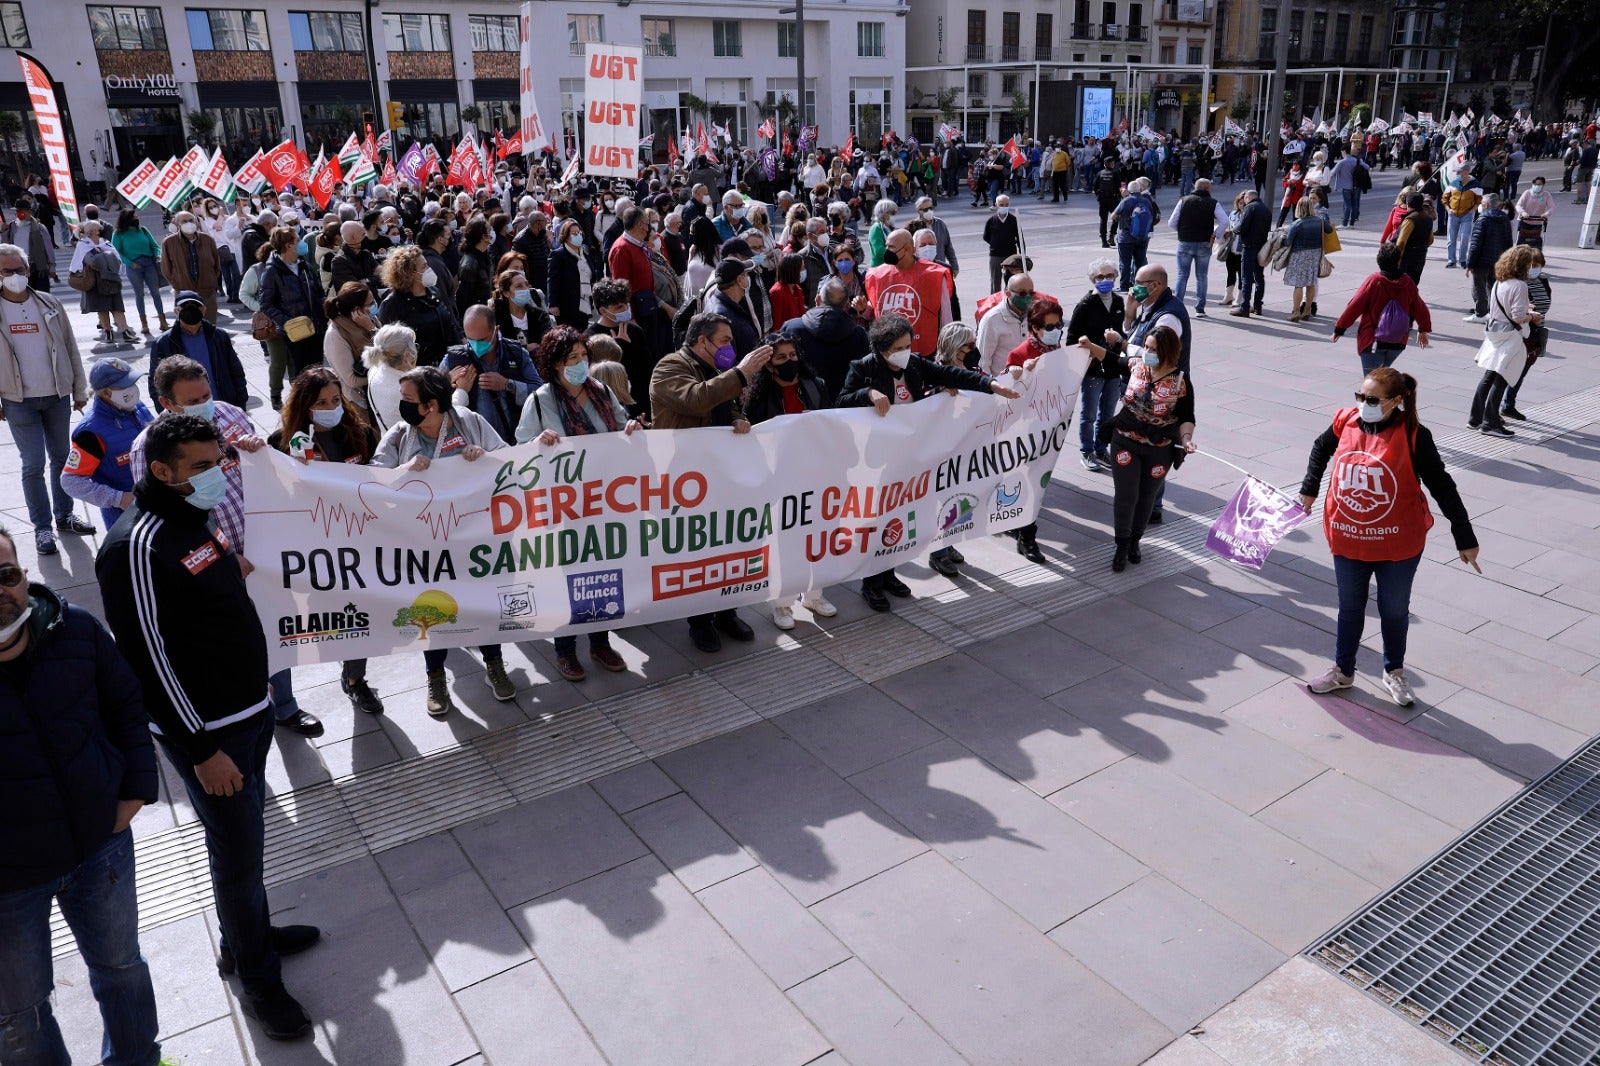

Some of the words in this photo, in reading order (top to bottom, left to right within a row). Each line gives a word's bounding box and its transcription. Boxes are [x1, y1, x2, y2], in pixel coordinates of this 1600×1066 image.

[589, 54, 638, 81] UGT
[589, 101, 637, 127] UGT
[523, 113, 542, 143] UGT
[589, 144, 635, 169] UGT
[883, 292, 914, 310] UGT
[549, 448, 586, 484] TU
[1338, 462, 1384, 494] UGT
[490, 471, 708, 535] DERECHO
[990, 507, 1024, 524] FADSP
[281, 547, 367, 592] POR
[375, 546, 457, 587] UNA
[468, 522, 627, 578] SANIDAD
[640, 503, 773, 558] PÚBLICA
[781, 490, 814, 531] DE
[821, 469, 932, 521] CALIDAD
[935, 455, 961, 493] EN
[1330, 521, 1357, 533] mano
[1365, 525, 1400, 535] mano
[805, 527, 877, 563] UGT
[874, 541, 917, 557] Málaga
[573, 573, 618, 587] marea
[659, 556, 748, 594] CCOO
[573, 587, 618, 601] blanca
[720, 580, 769, 597] Málaga
[280, 630, 370, 648] ASOCIACION
